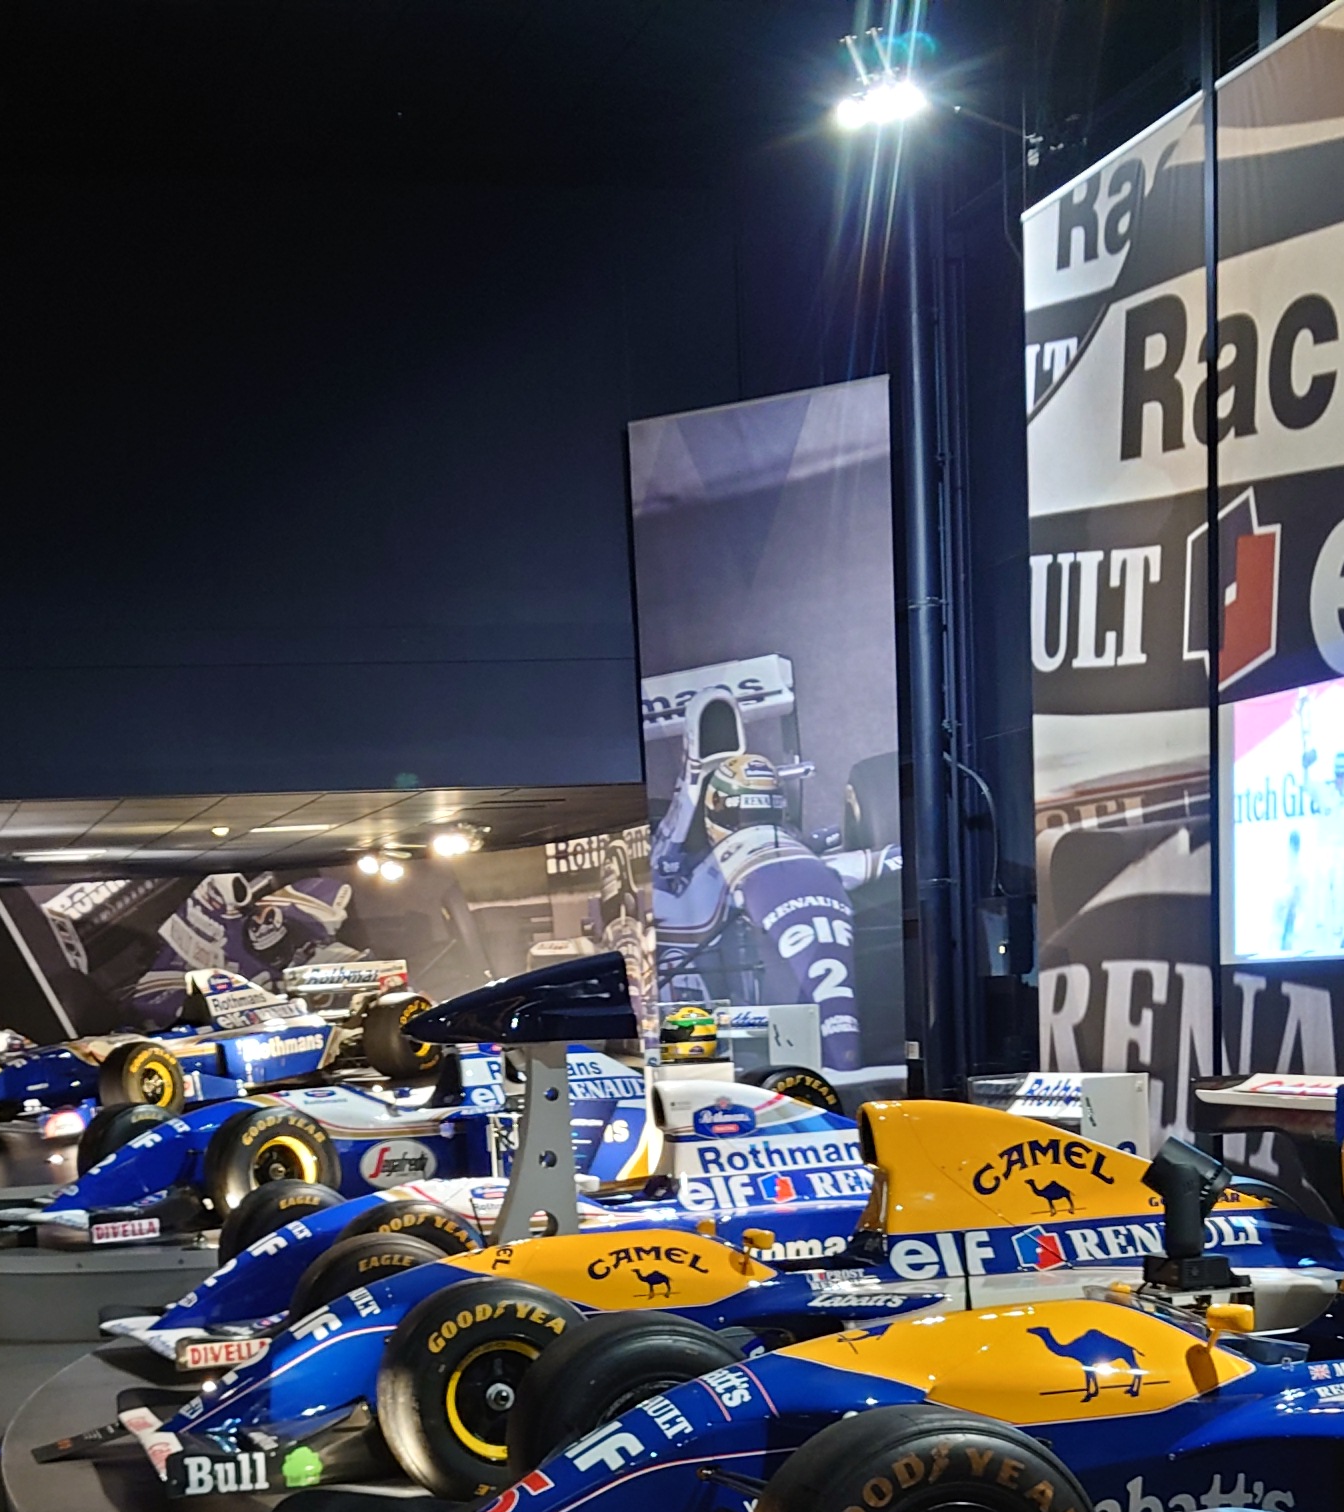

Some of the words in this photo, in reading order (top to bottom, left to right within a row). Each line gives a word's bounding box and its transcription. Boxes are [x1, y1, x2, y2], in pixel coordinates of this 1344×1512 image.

[1029, 545, 1161, 673] ULT
[778, 917, 853, 959] elf
[808, 958, 854, 1003] 2
[242, 1115, 326, 1146] GOODYEAR
[702, 1137, 863, 1174] Rothman
[972, 1138, 1115, 1195] CAMEL
[279, 1196, 321, 1210] EAGLE
[679, 1172, 754, 1212] elf
[94, 1220, 157, 1241] DIVELLA
[378, 1210, 484, 1253] OODYEAR
[890, 1229, 995, 1280] elf
[1064, 1216, 1262, 1263] RENLT
[358, 1254, 414, 1272] EAGLE
[587, 1245, 710, 1281] CAMEL
[824, 1267, 865, 1281] PROST
[807, 1292, 907, 1310] Labatt's
[428, 1299, 567, 1355] GOODYEA
[184, 1453, 270, 1496] Bull
